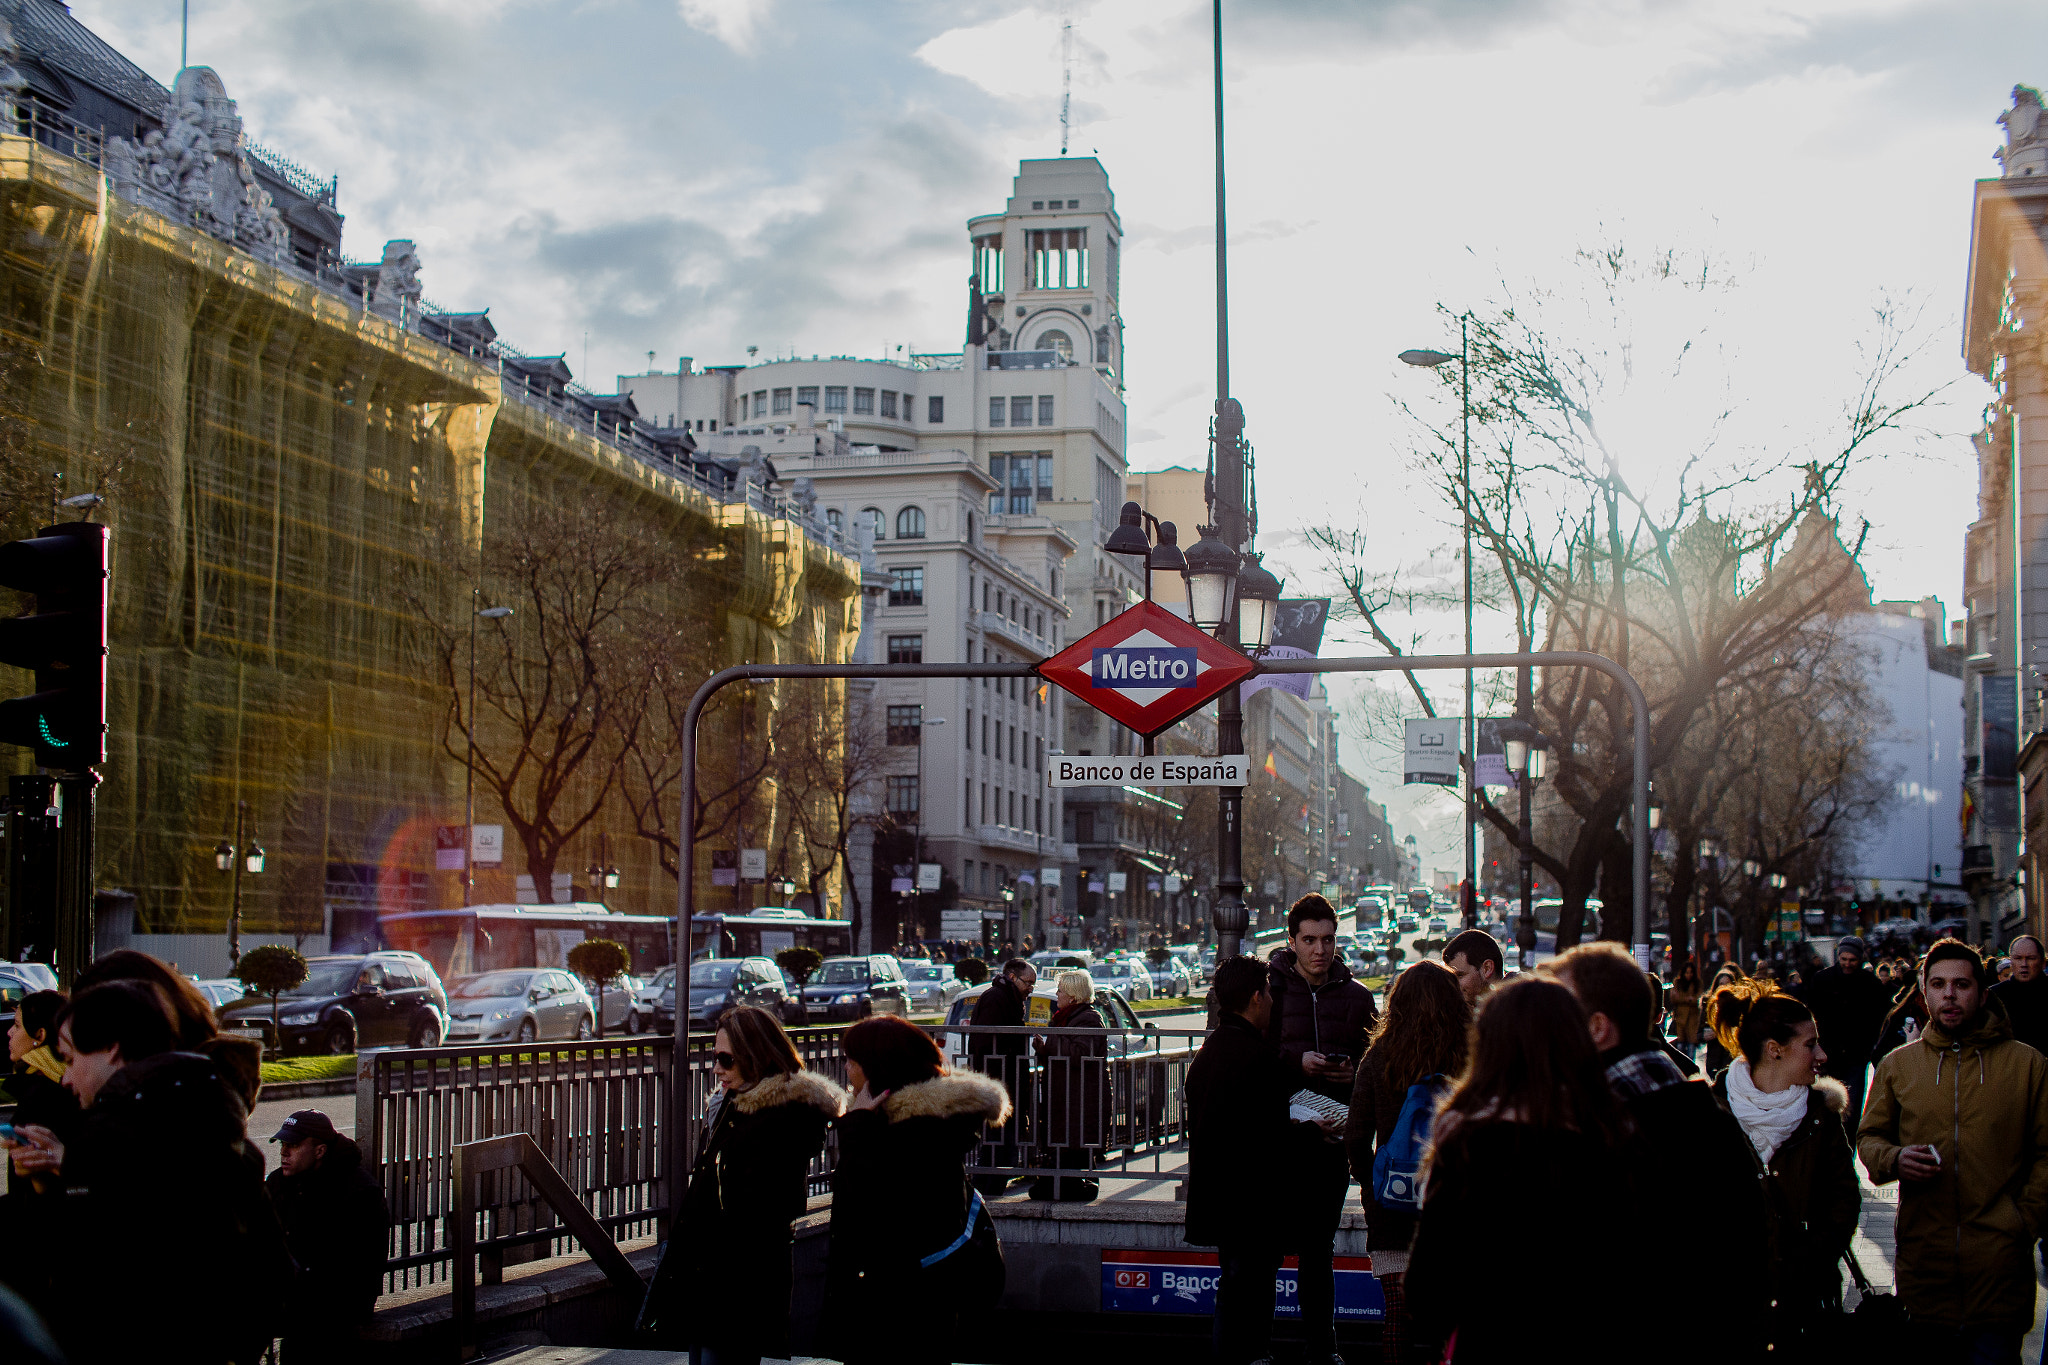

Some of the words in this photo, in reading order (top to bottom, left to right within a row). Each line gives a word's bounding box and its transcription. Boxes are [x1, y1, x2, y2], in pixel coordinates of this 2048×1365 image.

[1102, 653, 1189, 680] Metro
[1060, 762, 1123, 780] Banco
[1130, 762, 1154, 780] de
[1162, 761, 1238, 784] España
[1135, 1273, 1146, 1287] 2
[1338, 1306, 1382, 1315] Buenavista
